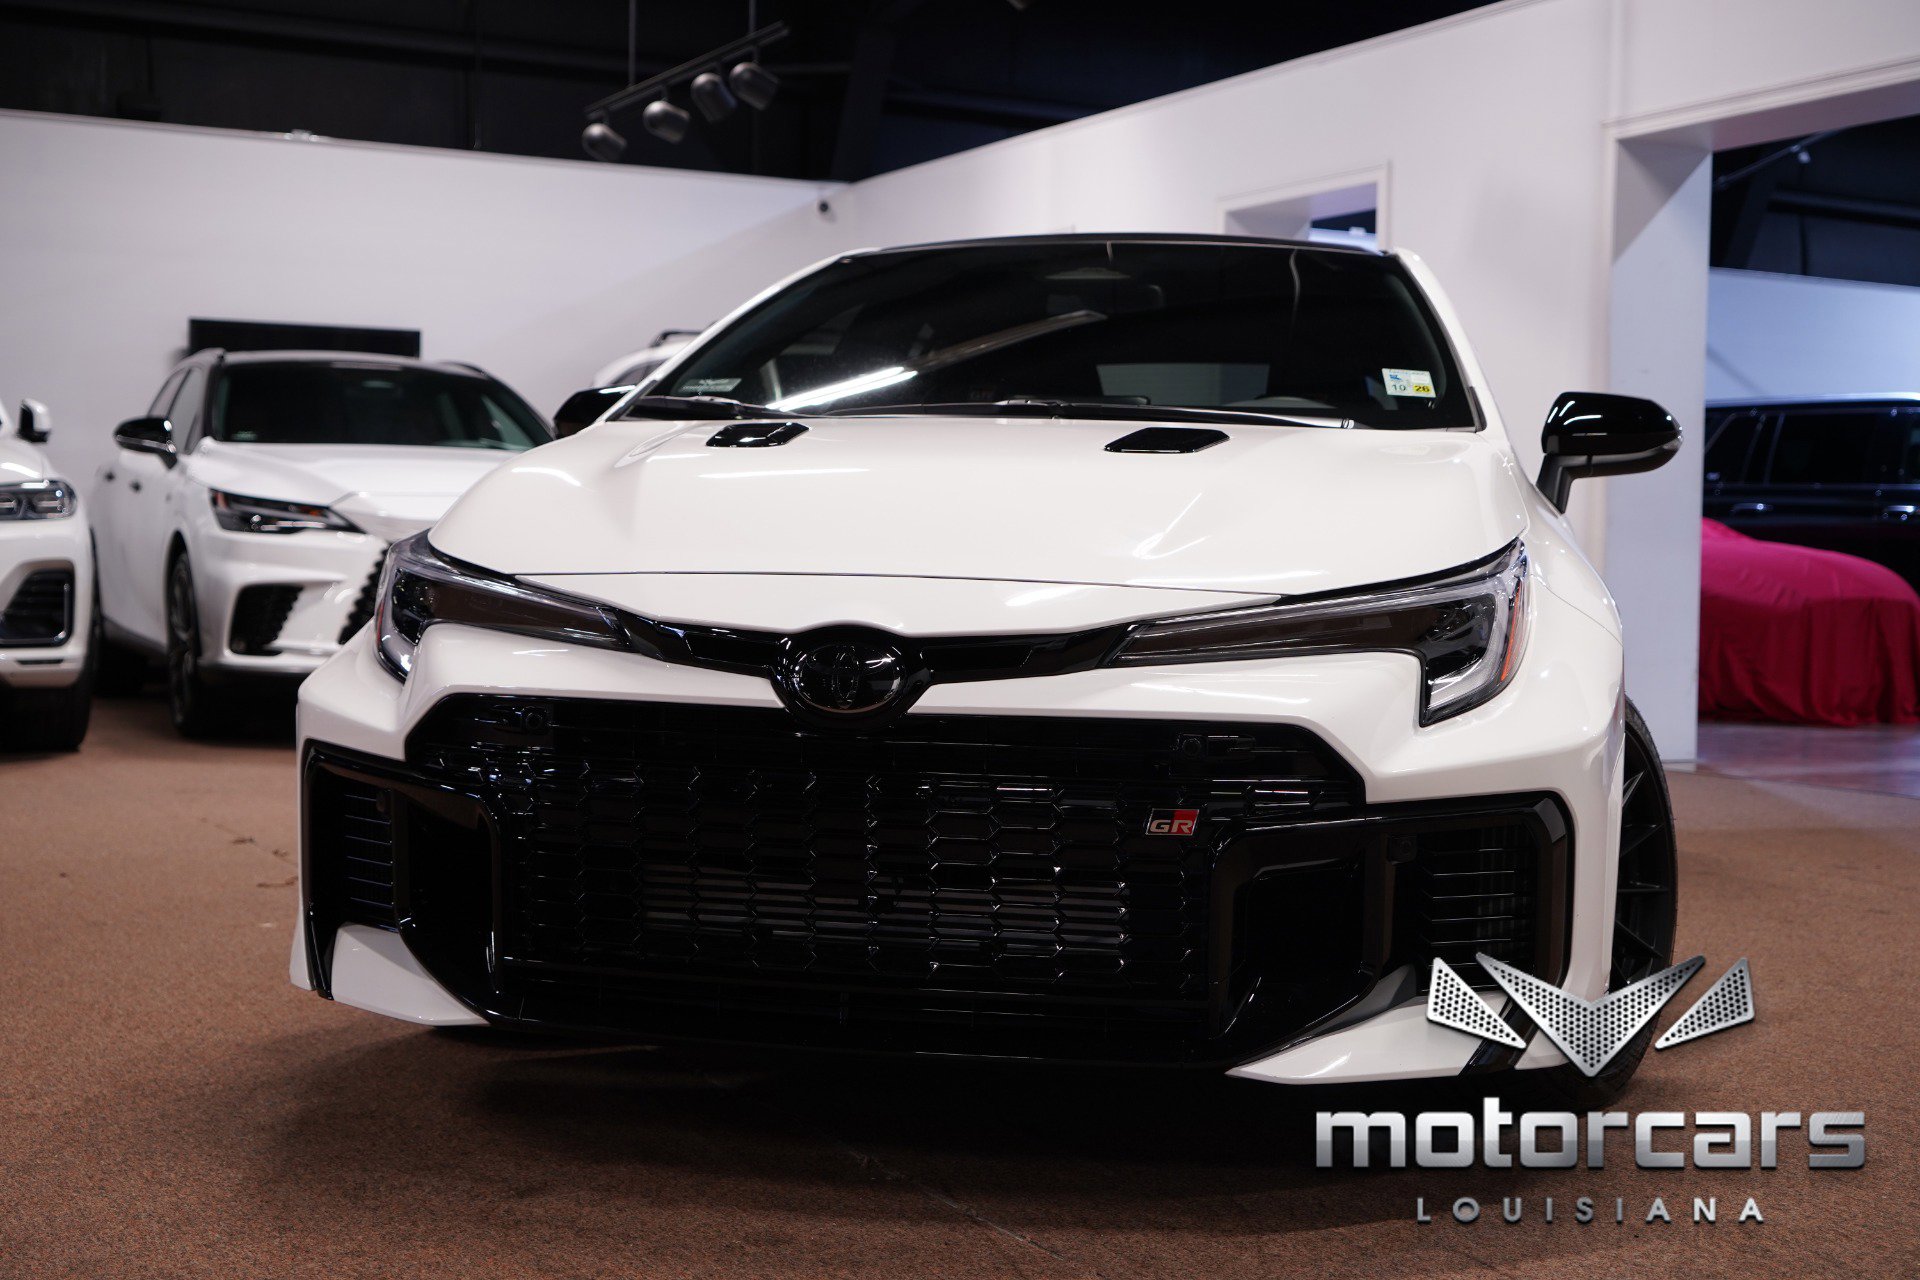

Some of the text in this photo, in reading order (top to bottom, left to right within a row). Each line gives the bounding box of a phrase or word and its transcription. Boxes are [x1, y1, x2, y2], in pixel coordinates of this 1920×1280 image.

[1392, 384, 1430, 393] 10 26
[1150, 819, 1193, 833] GR
